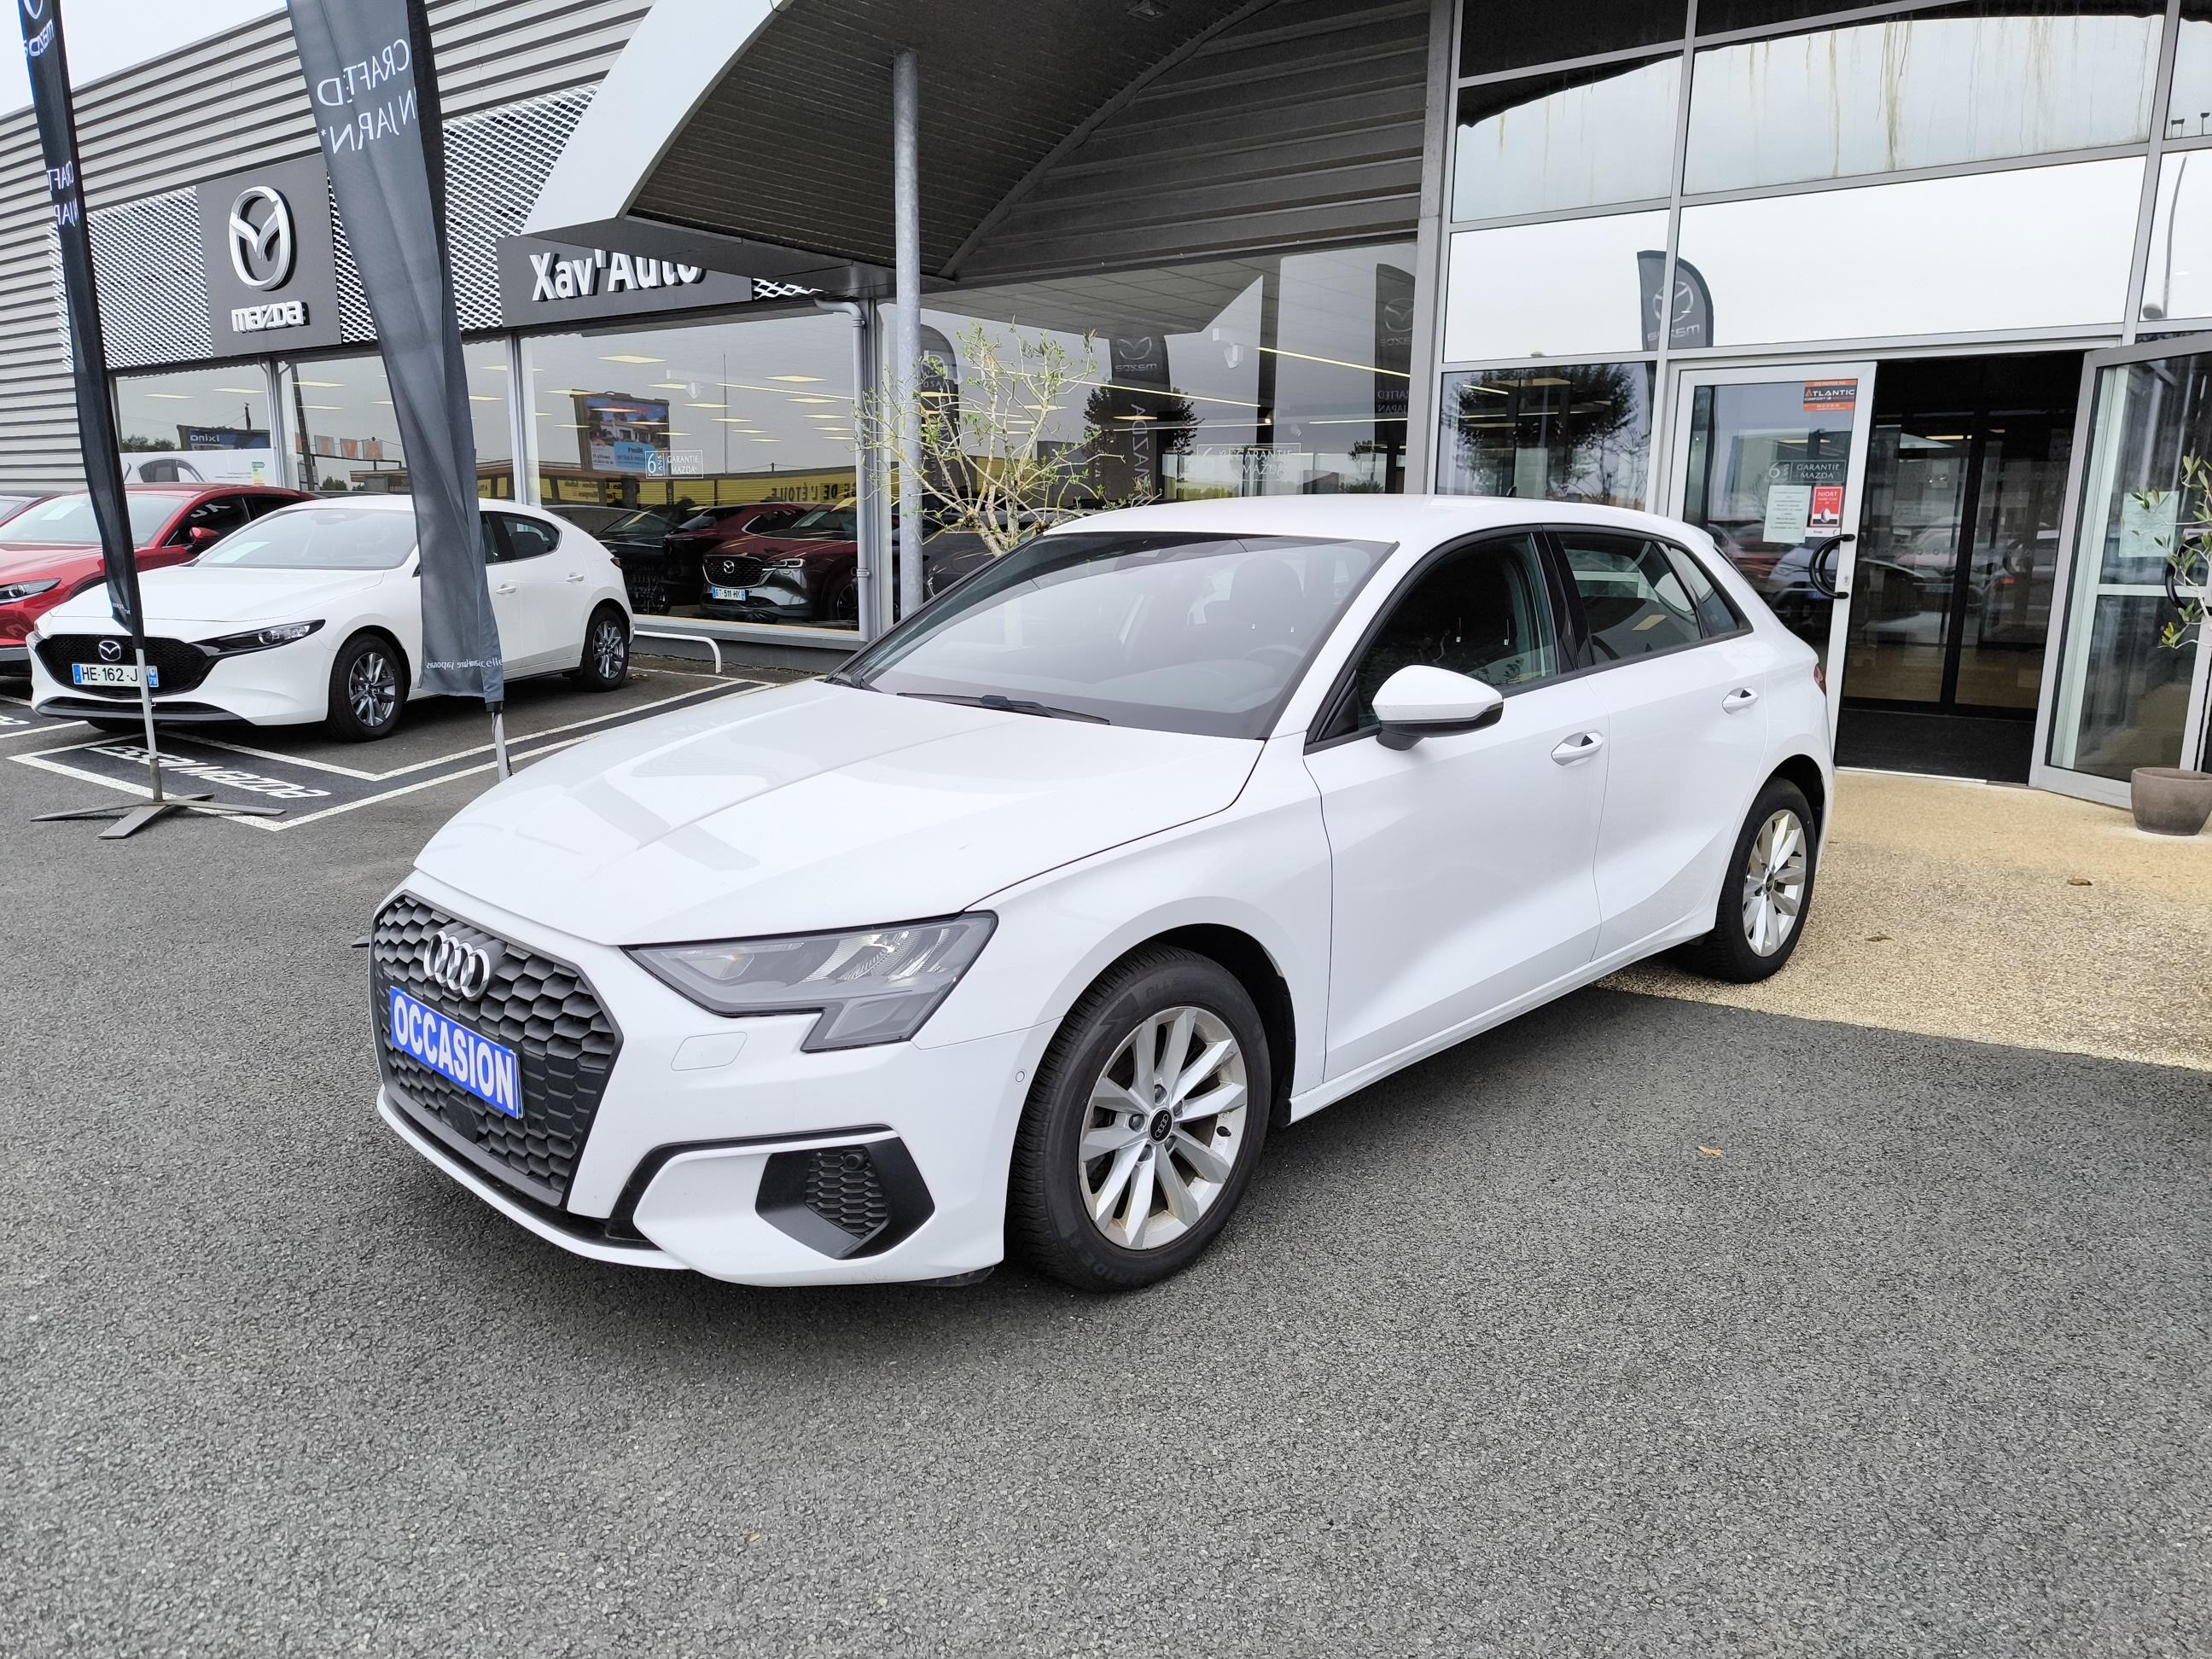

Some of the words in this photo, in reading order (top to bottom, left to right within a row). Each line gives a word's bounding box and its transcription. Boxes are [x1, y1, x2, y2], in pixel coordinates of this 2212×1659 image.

[529, 248, 703, 301] Xav'Auto
[1805, 388, 1855, 397] ATLANTIC
[647, 452, 656, 474] 6
[667, 455, 699, 463] GARANTIE
[671, 465, 695, 474] MAZDA
[1769, 462, 1780, 479] 6
[81, 667, 138, 682] HE-162-J
[393, 1002, 517, 1112] OCCASION
